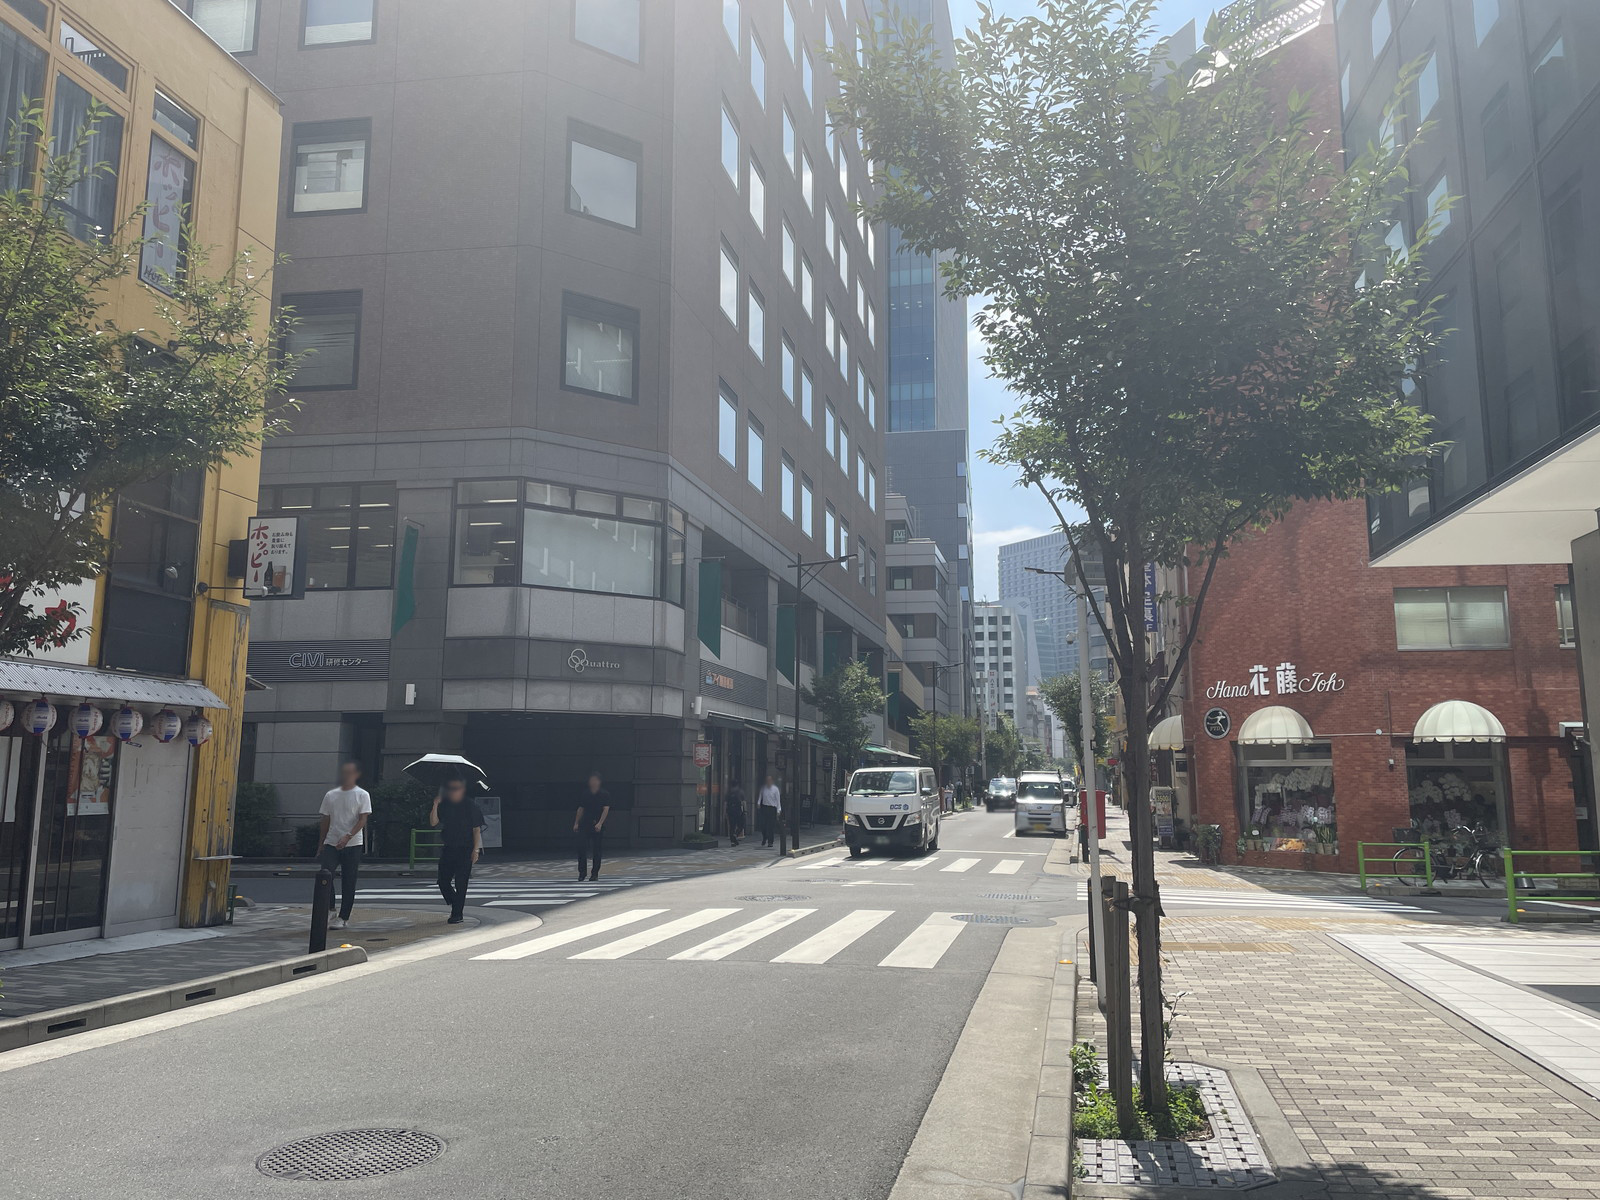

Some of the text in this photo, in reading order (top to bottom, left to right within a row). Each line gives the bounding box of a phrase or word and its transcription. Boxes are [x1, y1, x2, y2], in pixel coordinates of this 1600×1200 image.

[251, 521, 269, 582] ホッピー
[289, 652, 325, 668] CIVI
[1206, 680, 1250, 699] Hana
[695, 746, 709, 761] 薬
